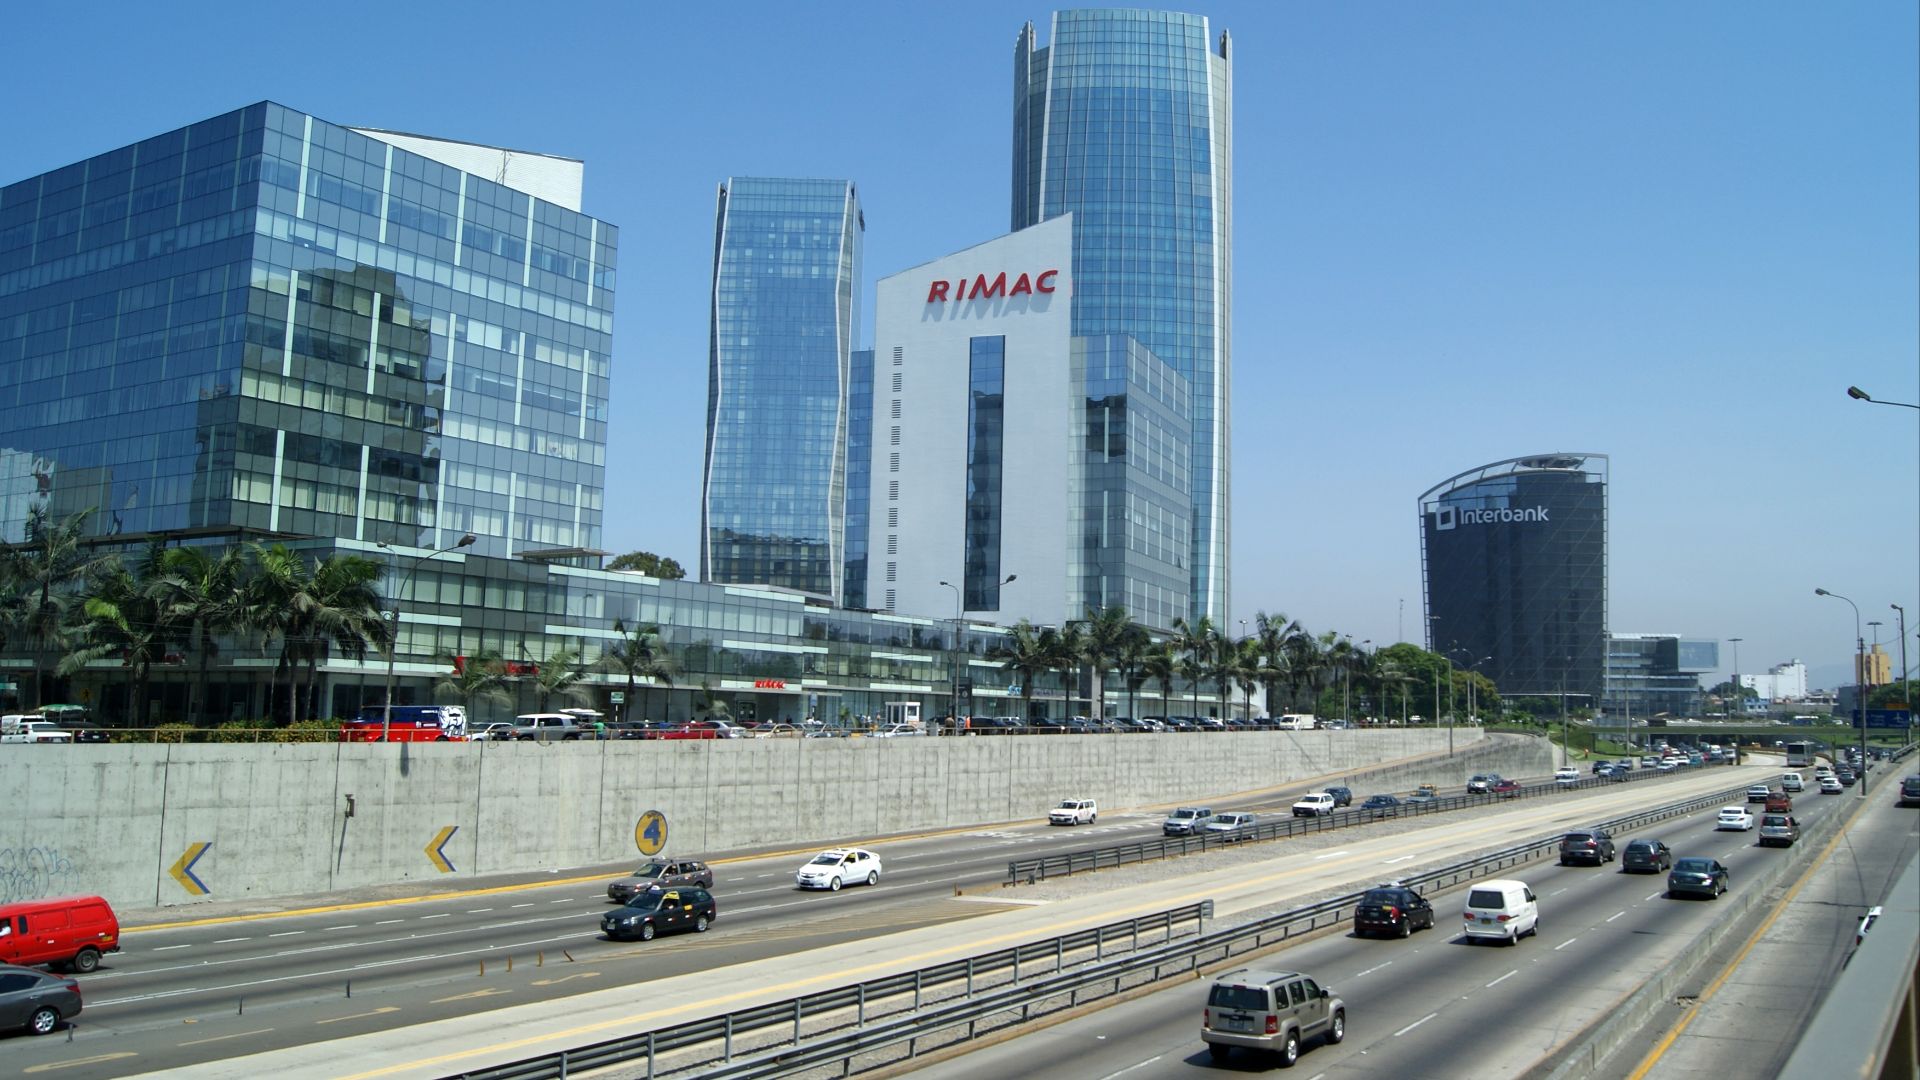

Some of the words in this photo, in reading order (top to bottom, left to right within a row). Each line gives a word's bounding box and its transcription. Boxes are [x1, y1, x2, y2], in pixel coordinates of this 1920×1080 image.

[928, 270, 1058, 303] RIMAC
[1460, 505, 1549, 525] Interbank
[644, 819, 661, 846] 4
